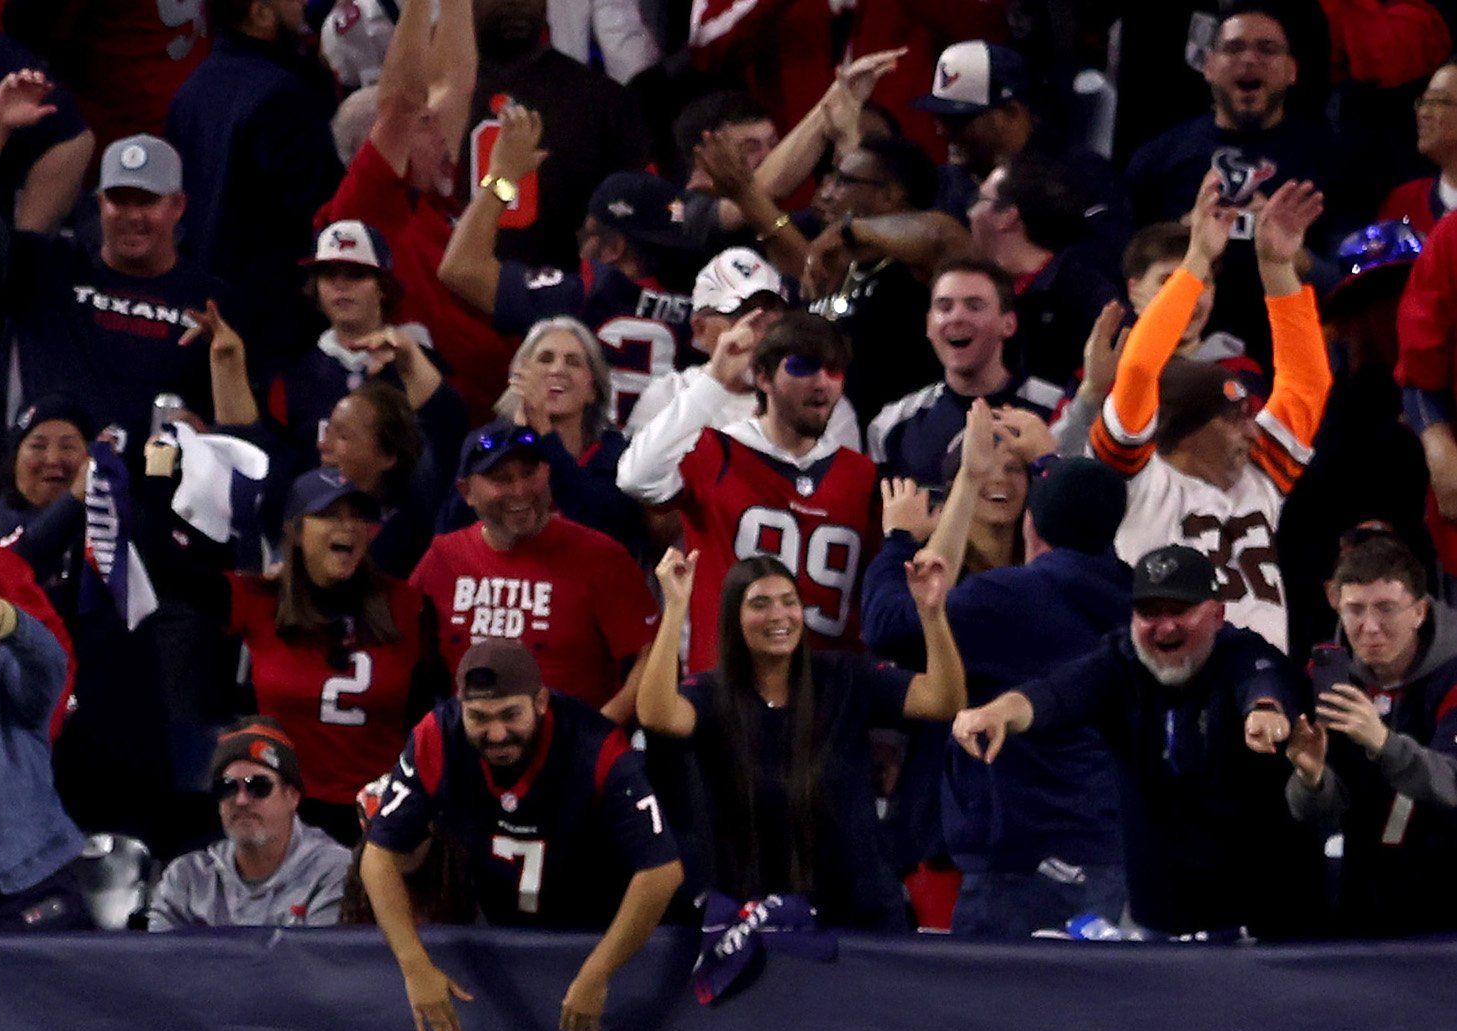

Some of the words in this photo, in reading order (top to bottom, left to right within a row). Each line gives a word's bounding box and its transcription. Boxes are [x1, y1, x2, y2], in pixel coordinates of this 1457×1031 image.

[733, 505, 861, 638] 99
[1181, 511, 1282, 606] 32
[452, 575, 553, 617] BATTLE
[470, 607, 525, 638] RED
[320, 650, 372, 726] 2
[380, 778, 413, 819] 7
[635, 793, 664, 835] 7
[491, 834, 545, 914] 7
